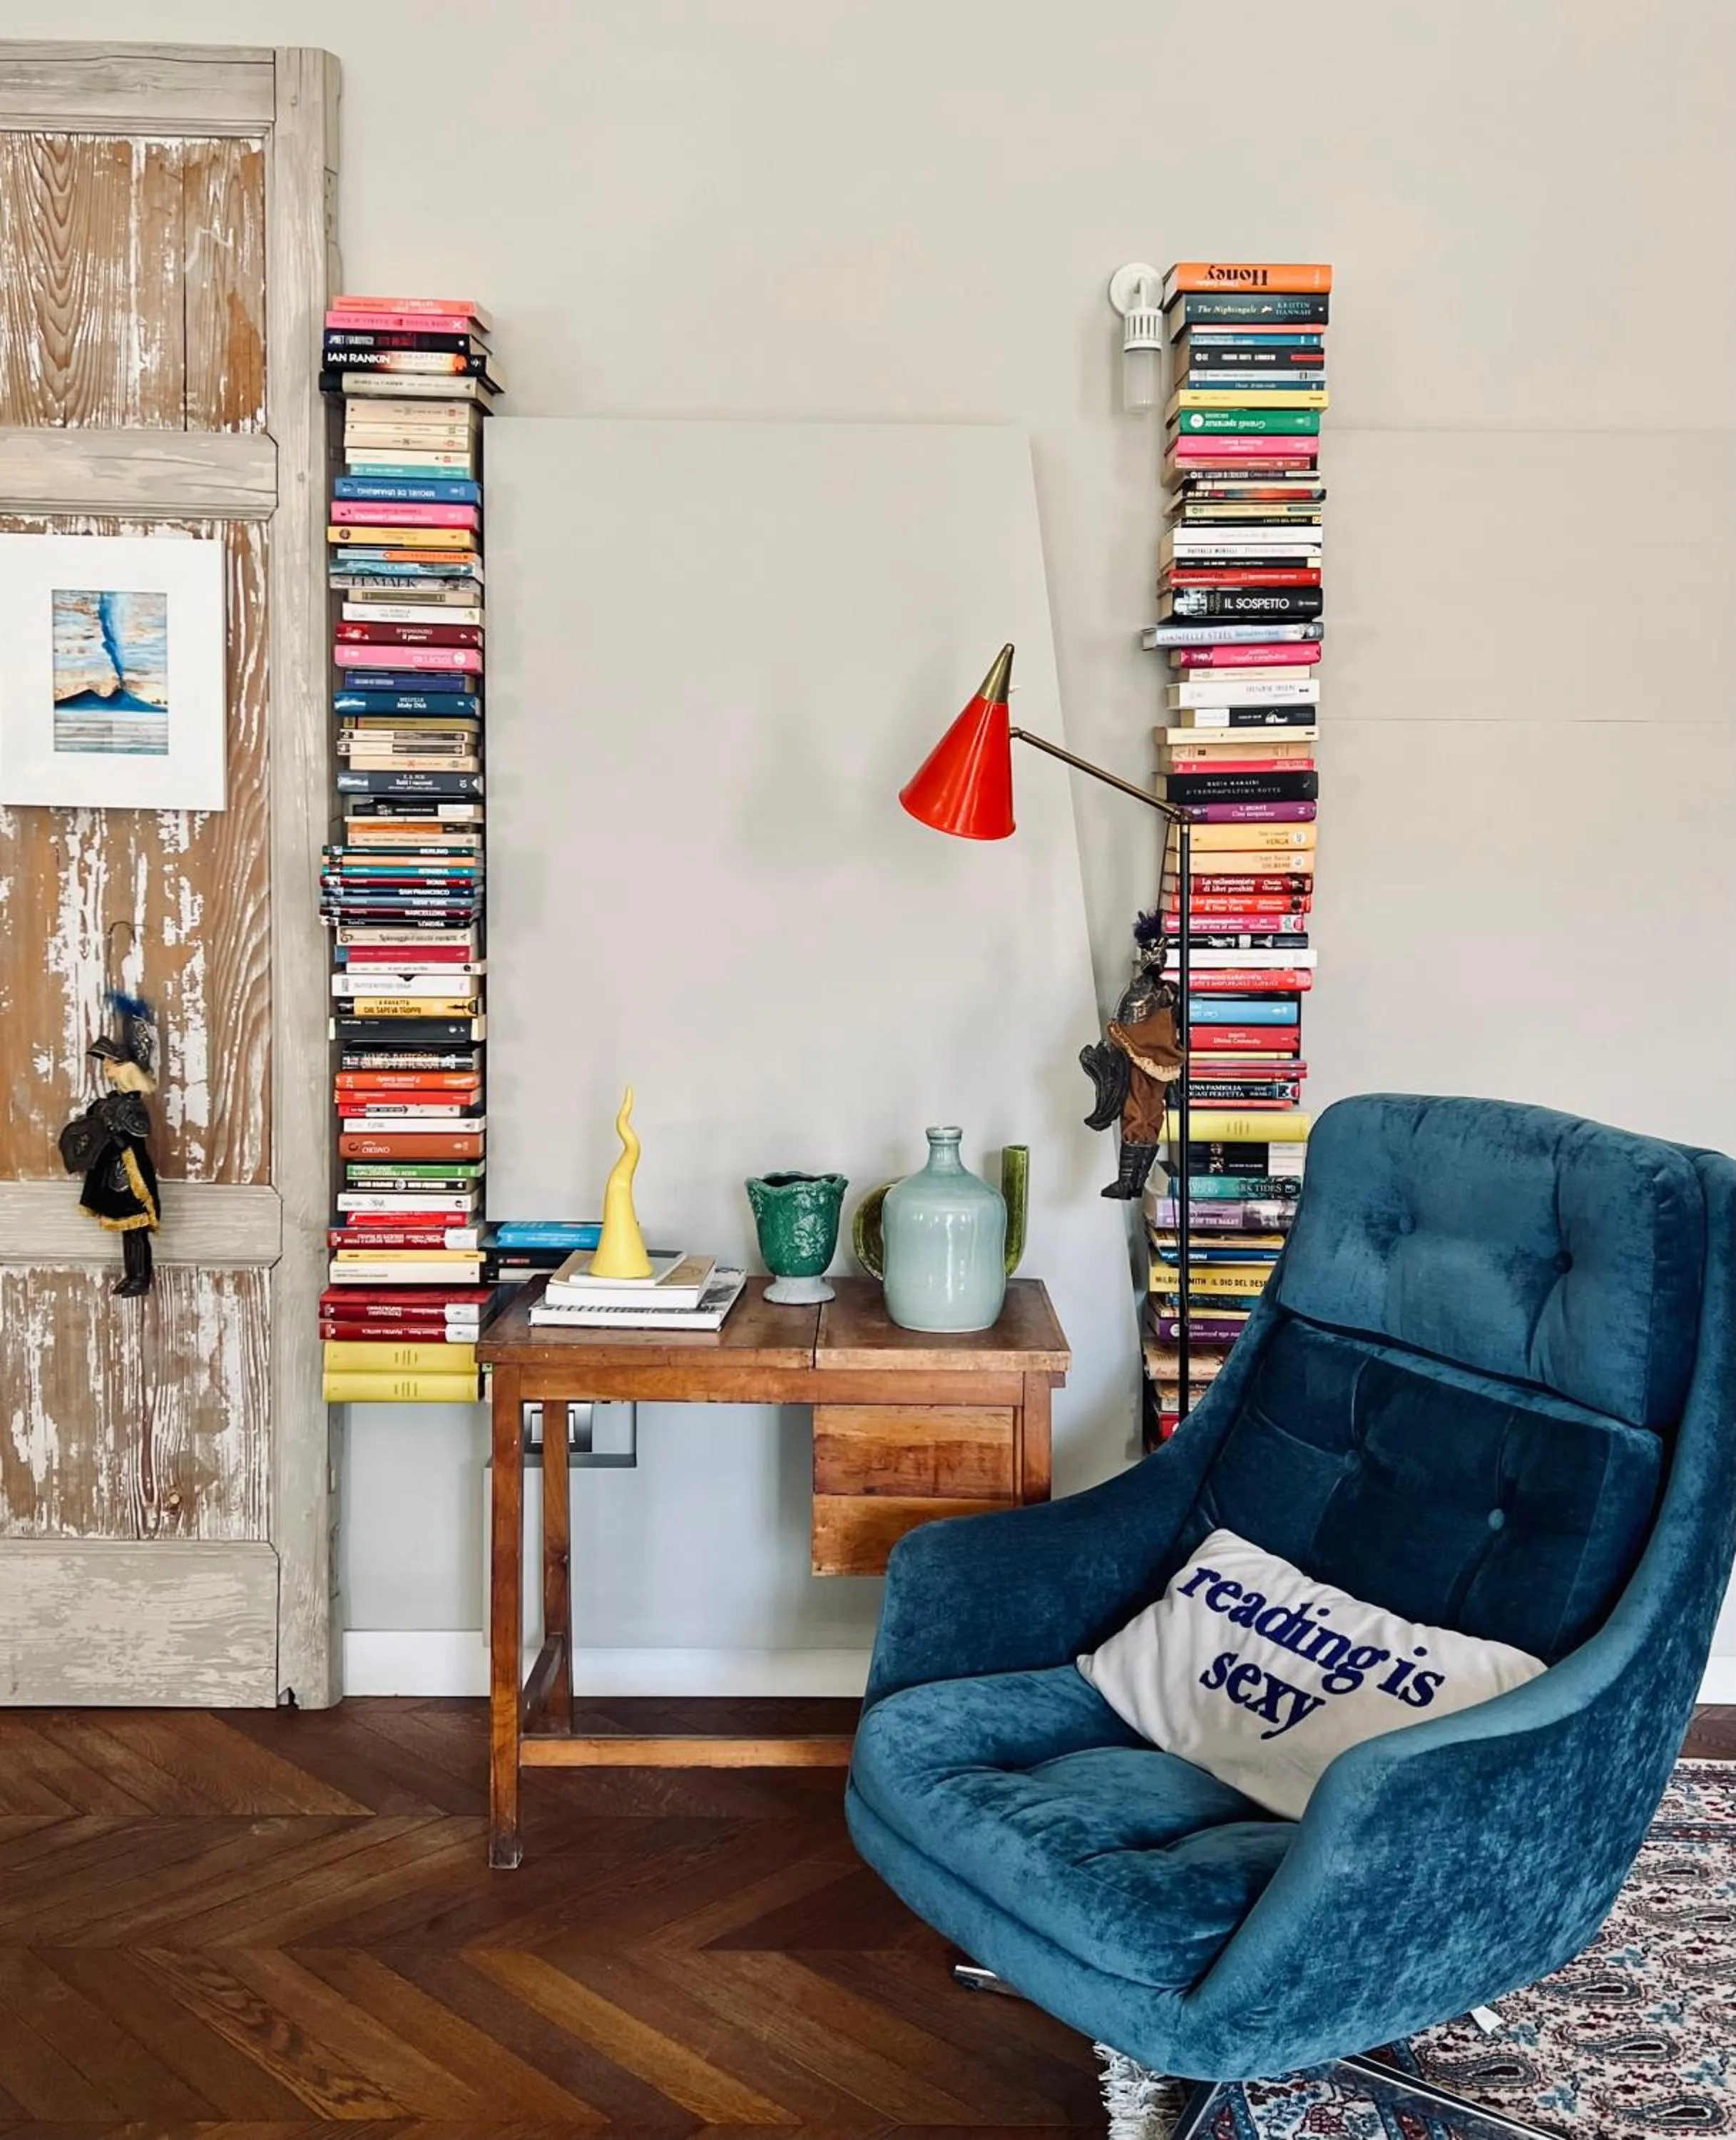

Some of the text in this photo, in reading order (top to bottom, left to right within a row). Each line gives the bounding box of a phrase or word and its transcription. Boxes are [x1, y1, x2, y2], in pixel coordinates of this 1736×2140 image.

[1205, 265, 1268, 287] Honey
[1198, 305, 1257, 315] The Nightingale
[327, 352, 391, 365] IAN RANKIN
[1225, 598, 1290, 609] IL SOSPETTO
[1255, 1183, 1282, 1193] TIDES
[1155, 1275, 1206, 1285] WILBU MITH
[1177, 1567, 1445, 1707] reading is
[1199, 1651, 1327, 1740] sexy
